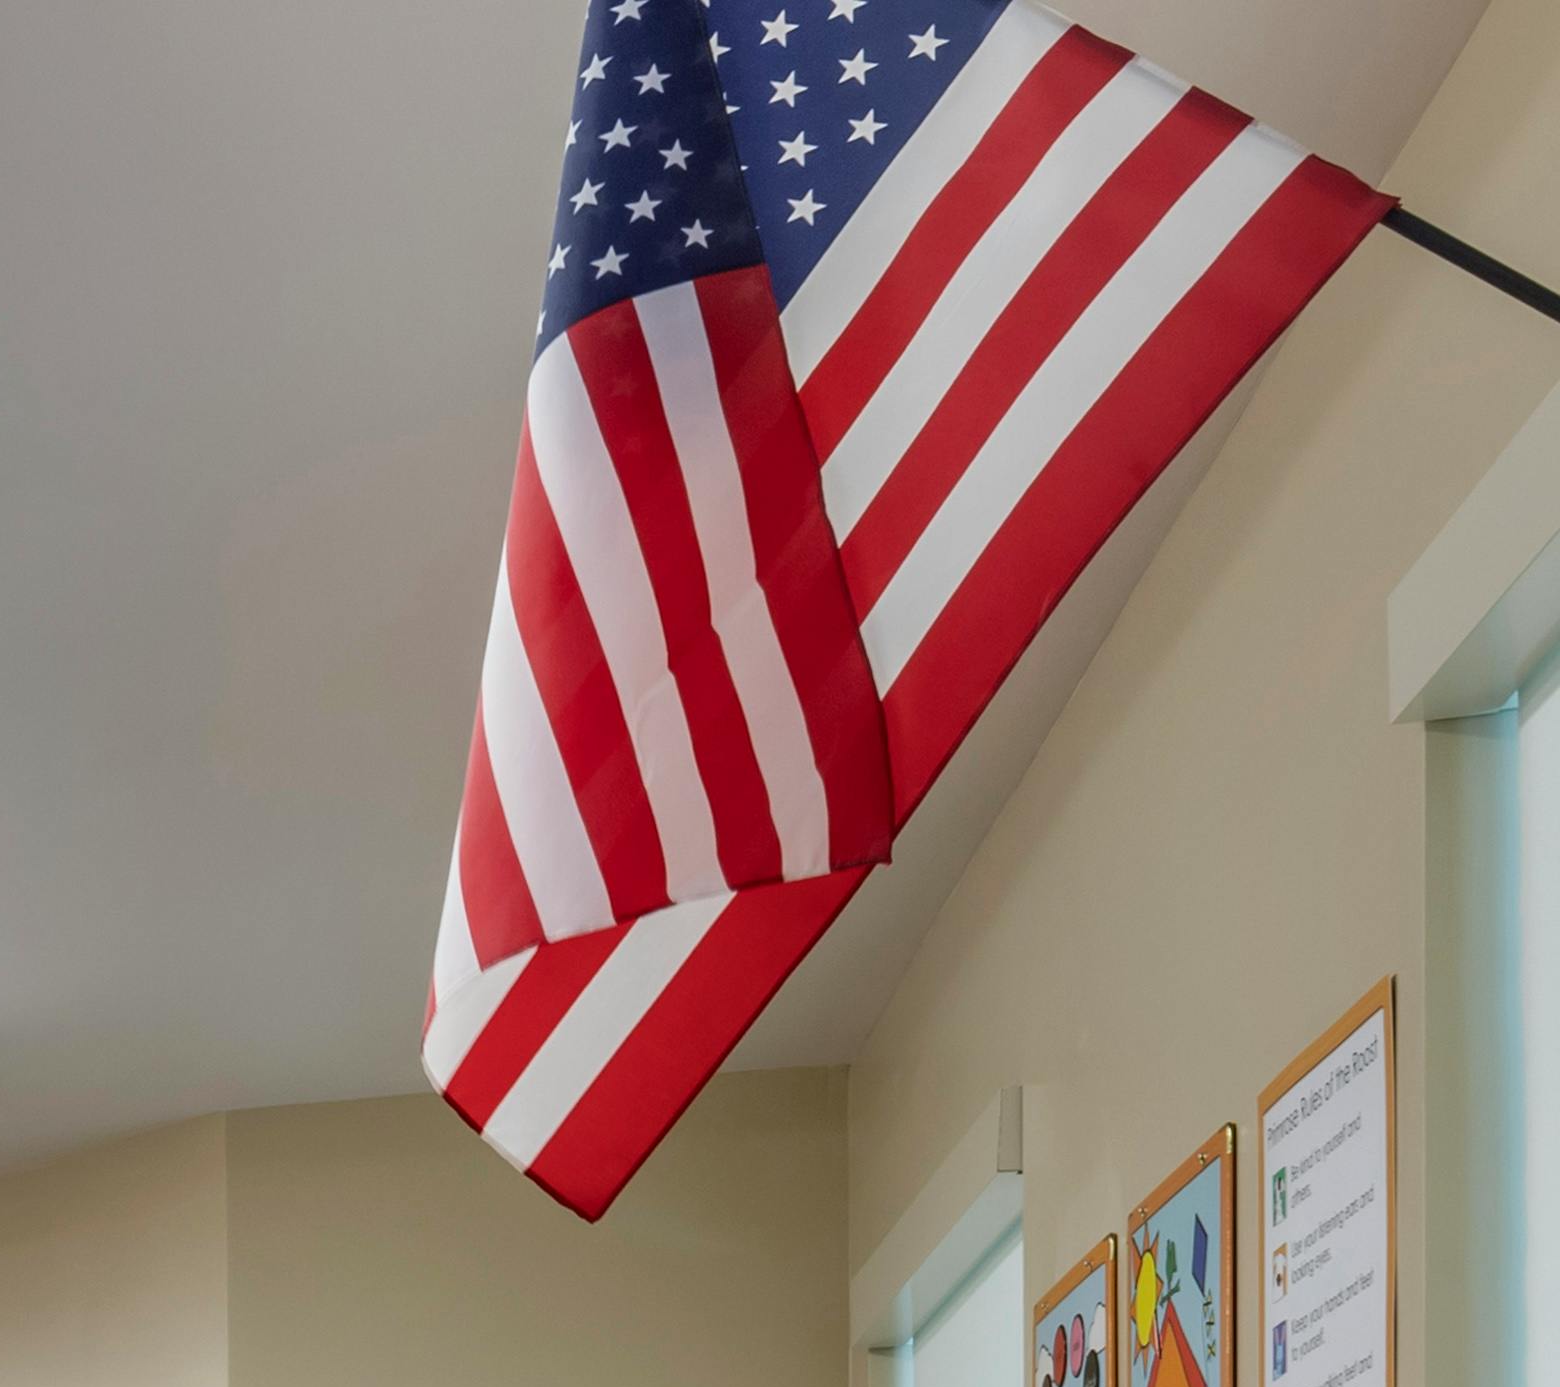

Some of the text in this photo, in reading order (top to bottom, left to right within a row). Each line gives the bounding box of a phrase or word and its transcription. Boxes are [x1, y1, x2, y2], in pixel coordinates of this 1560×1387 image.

[1267, 1036, 1377, 1144] Primrose Rules of the Roost
[1322, 1123, 1346, 1156] yourself
[1347, 1112, 1361, 1137] and
[1304, 1229, 1316, 1248] your
[1318, 1210, 1343, 1238] listening
[1345, 1199, 1358, 1220] ears
[1360, 1185, 1374, 1208] and
[1291, 1259, 1313, 1284] looking
[1309, 1304, 1323, 1327] your
[1324, 1290, 1344, 1312] hands
[1345, 1280, 1359, 1301] and
[1360, 1270, 1373, 1290] feet
[1344, 1361, 1356, 1382] feet
[1358, 1352, 1372, 1374] and
